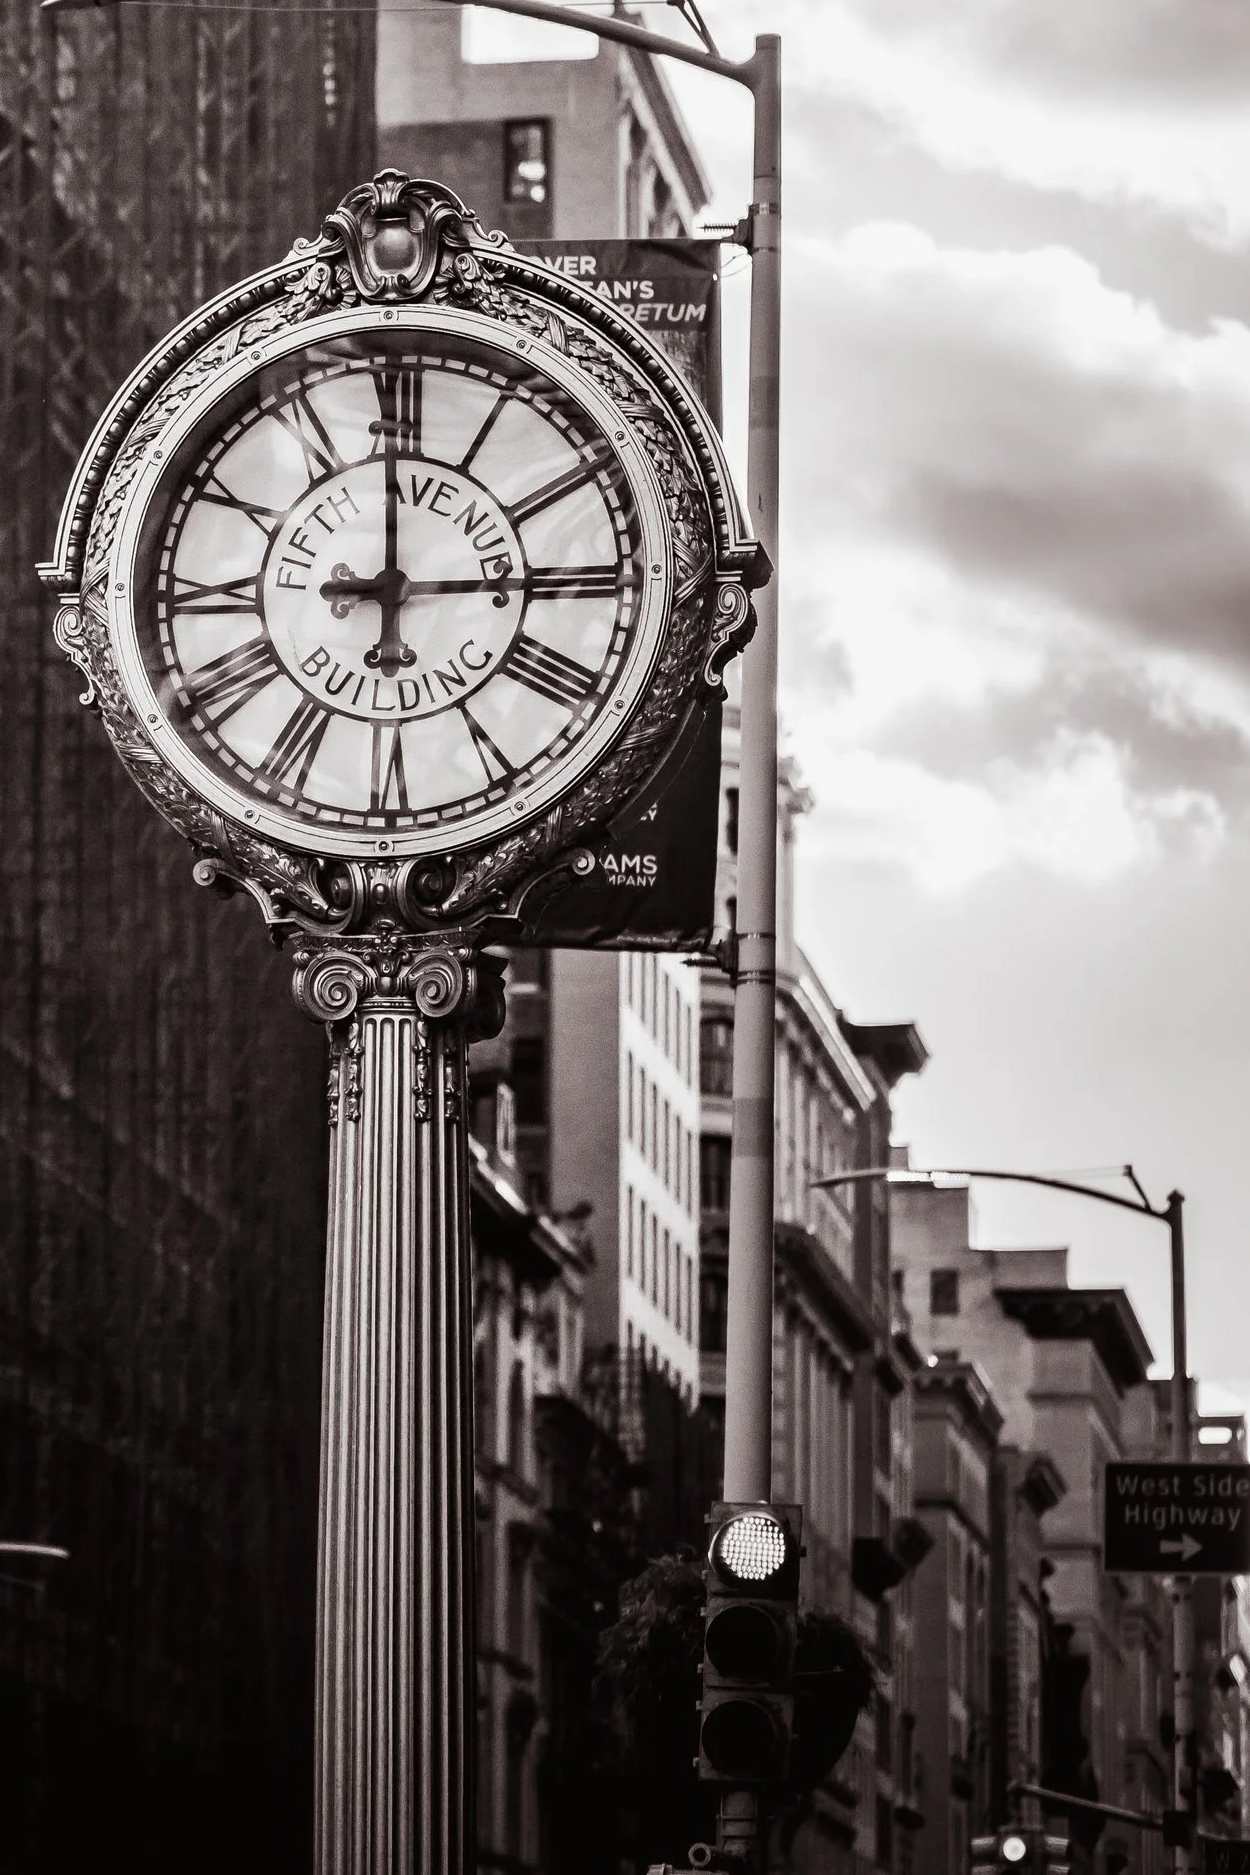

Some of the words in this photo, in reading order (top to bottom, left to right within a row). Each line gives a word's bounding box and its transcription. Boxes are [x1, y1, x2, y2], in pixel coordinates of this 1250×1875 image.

[275, 486, 360, 591] FIFTH
[299, 638, 493, 713] BUILDING
[1115, 1473, 1181, 1497] West
[1192, 1473, 1250, 1499] Side
[1124, 1501, 1241, 1533] Highway
